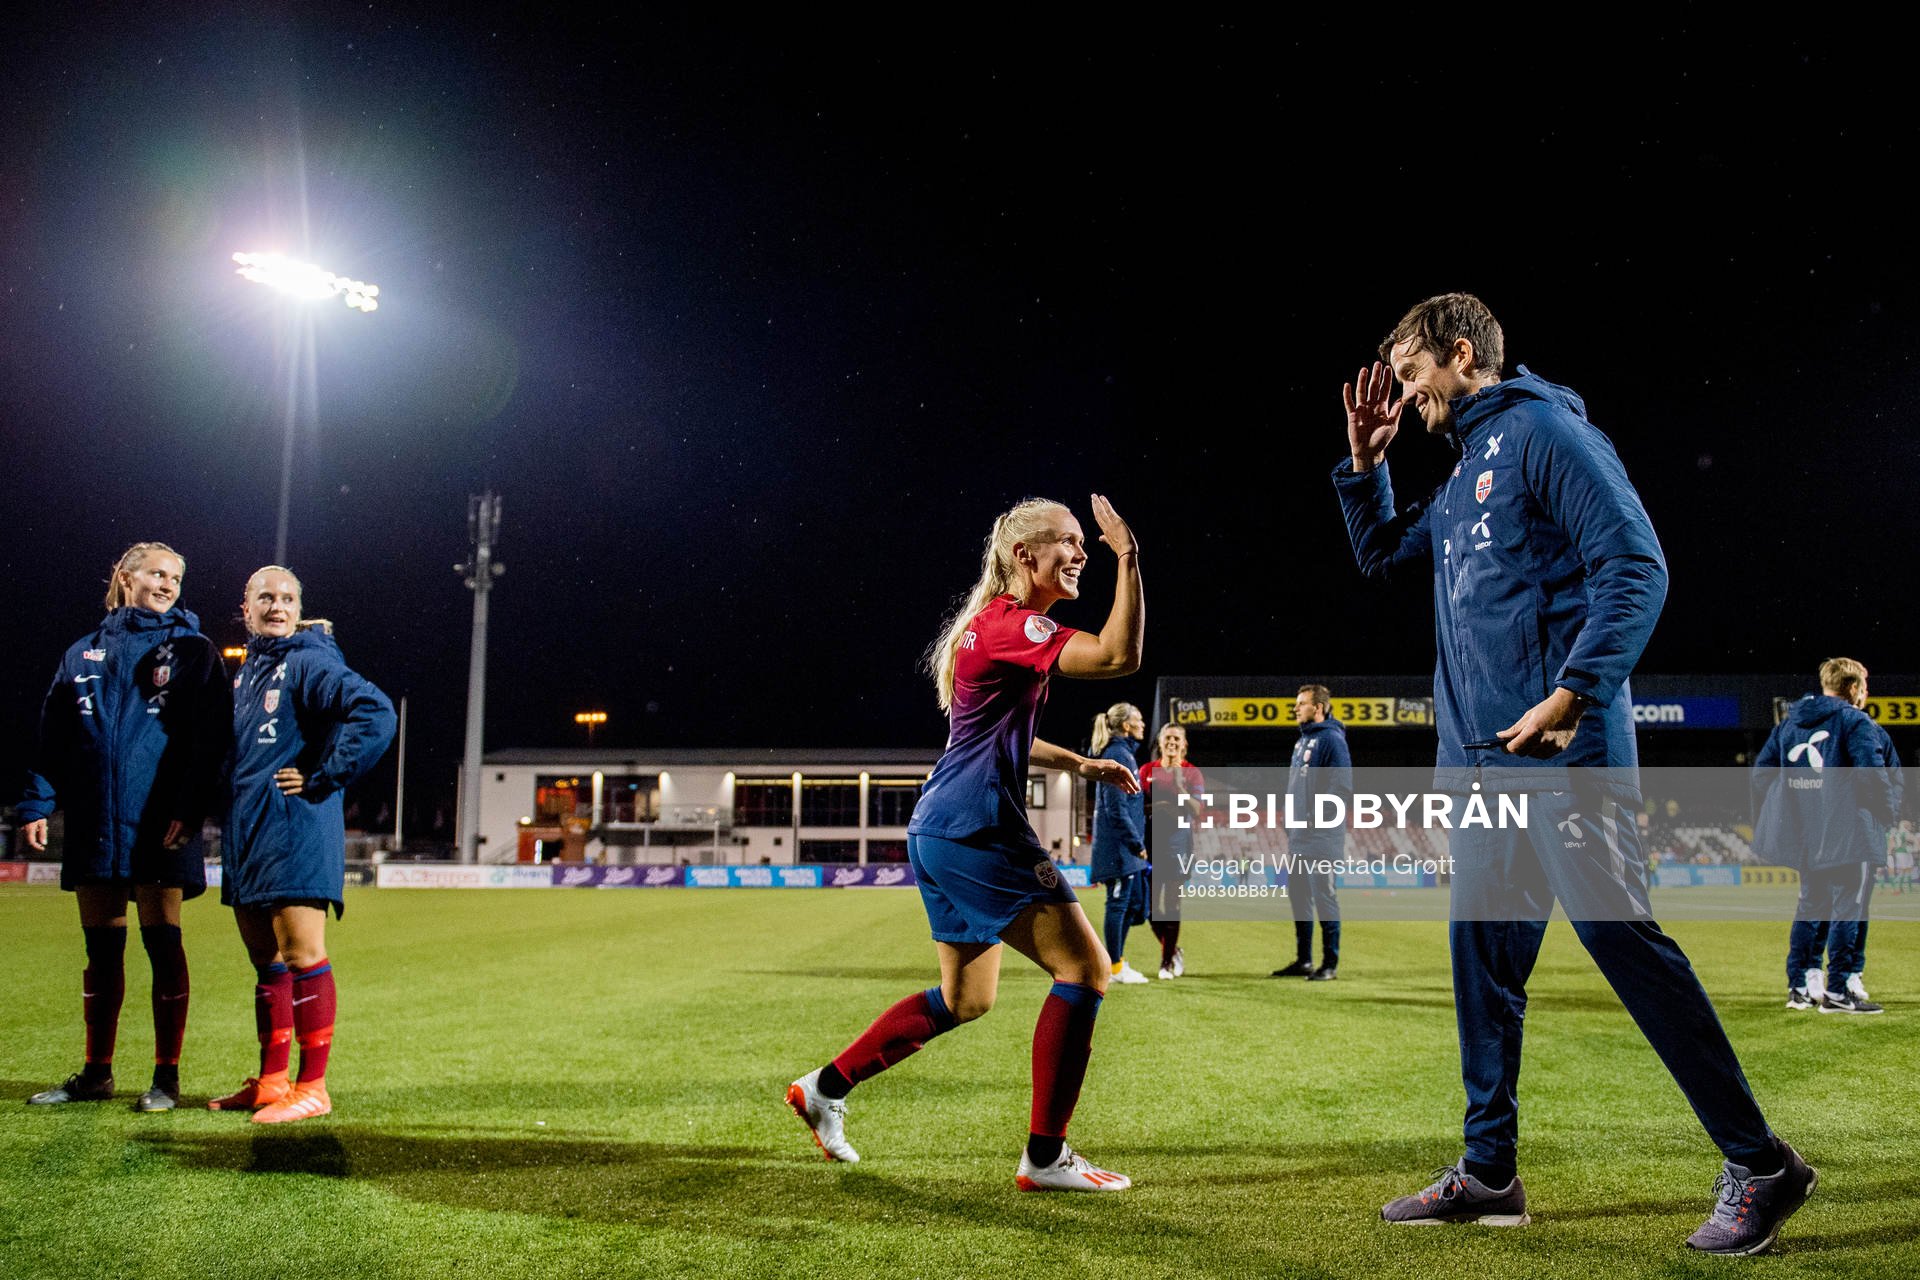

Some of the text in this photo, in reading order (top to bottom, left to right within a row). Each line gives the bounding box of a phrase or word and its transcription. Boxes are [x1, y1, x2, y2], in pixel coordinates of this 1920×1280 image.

[1177, 700, 1205, 711] fona
[1214, 711, 1238, 721] 028
[1243, 703, 1279, 721] 90
[1341, 703, 1389, 721] 333
[1398, 699, 1426, 712] fona
[1177, 710, 1207, 724] CAB
[1397, 710, 1426, 723] CAB
